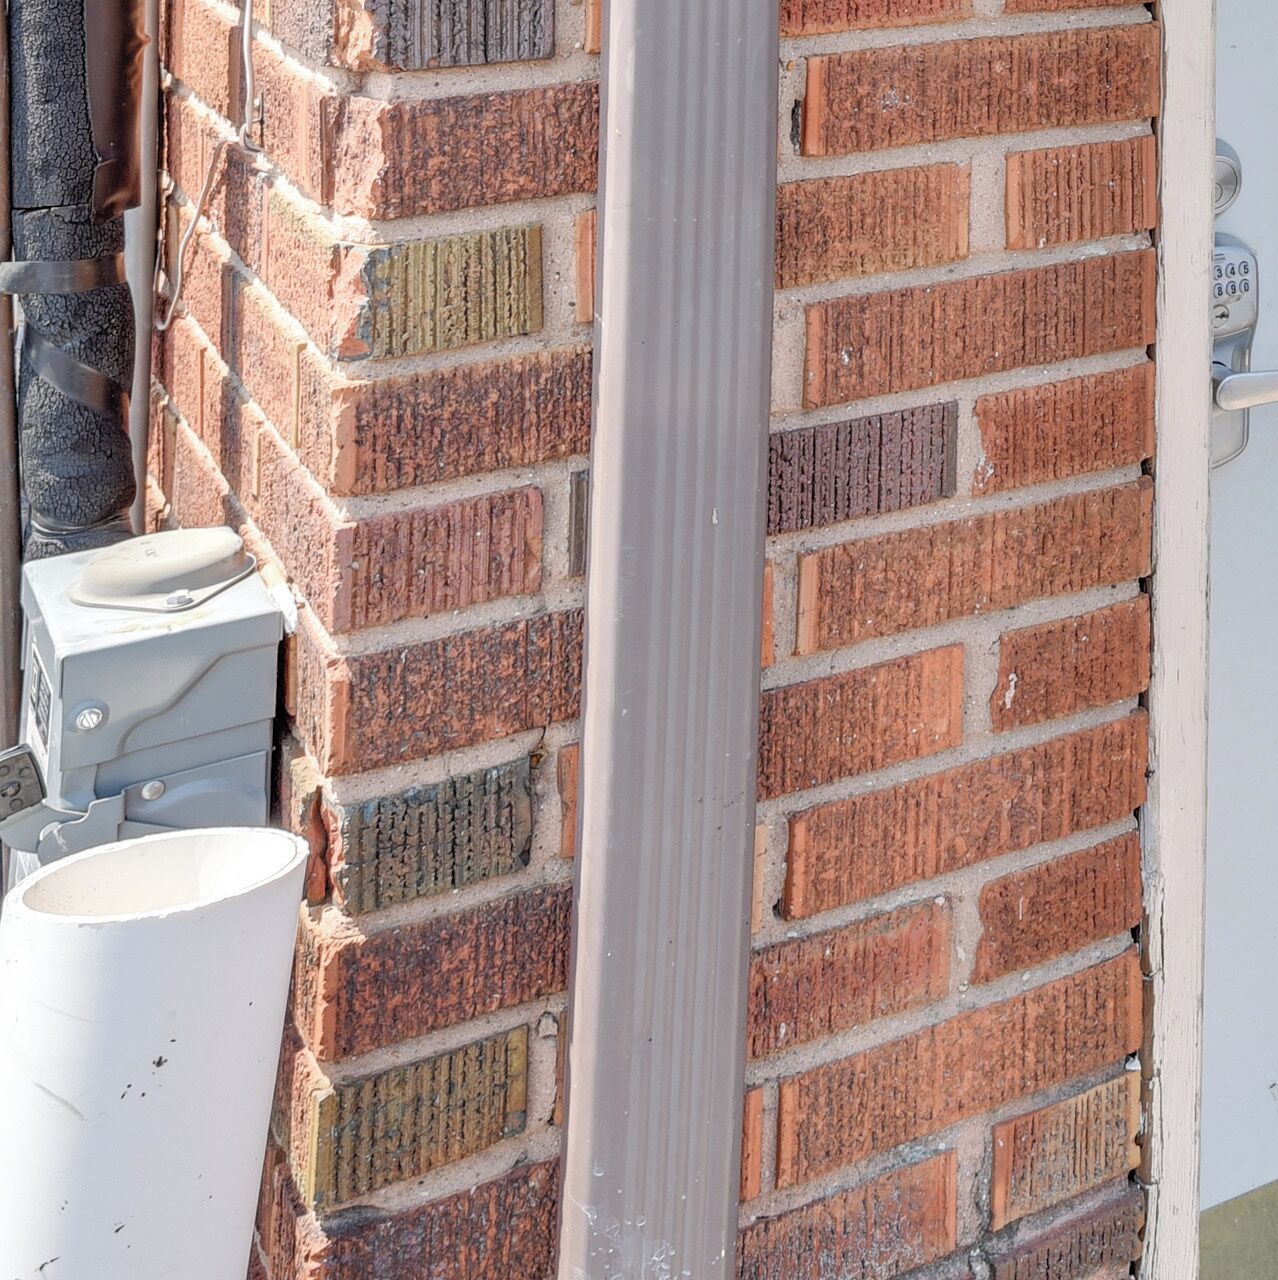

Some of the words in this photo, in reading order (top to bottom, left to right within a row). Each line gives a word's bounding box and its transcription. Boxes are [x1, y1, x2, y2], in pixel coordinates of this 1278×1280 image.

[1216, 268, 1222, 278] 3
[1230, 266, 1235, 275] 4
[1243, 264, 1249, 274] 5
[1217, 286, 1223, 296] 8
[1230, 284, 1236, 294] 9
[1243, 282, 1249, 292] 0
